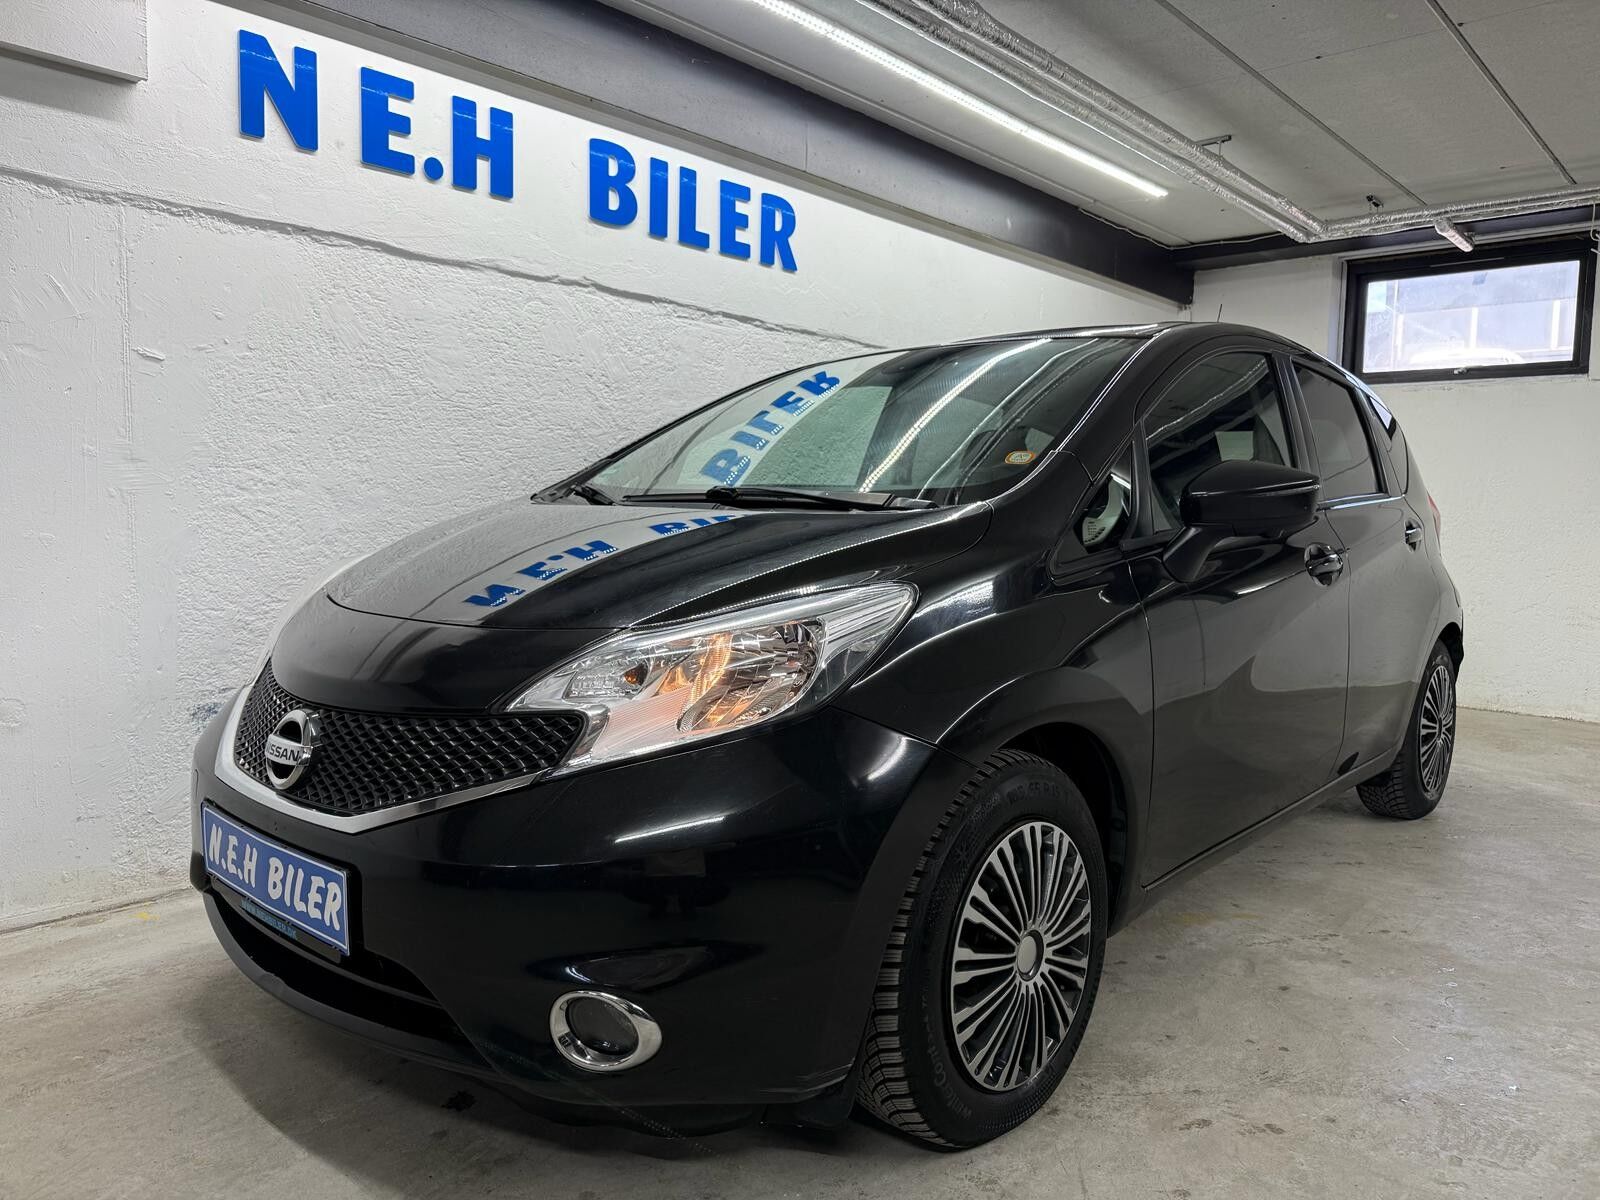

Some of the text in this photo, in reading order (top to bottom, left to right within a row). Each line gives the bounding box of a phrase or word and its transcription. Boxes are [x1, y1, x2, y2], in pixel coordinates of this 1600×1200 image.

[589, 138, 798, 272] BILER
[266, 742, 300, 762] SSAN
[208, 824, 343, 931] N.E.H BILER
